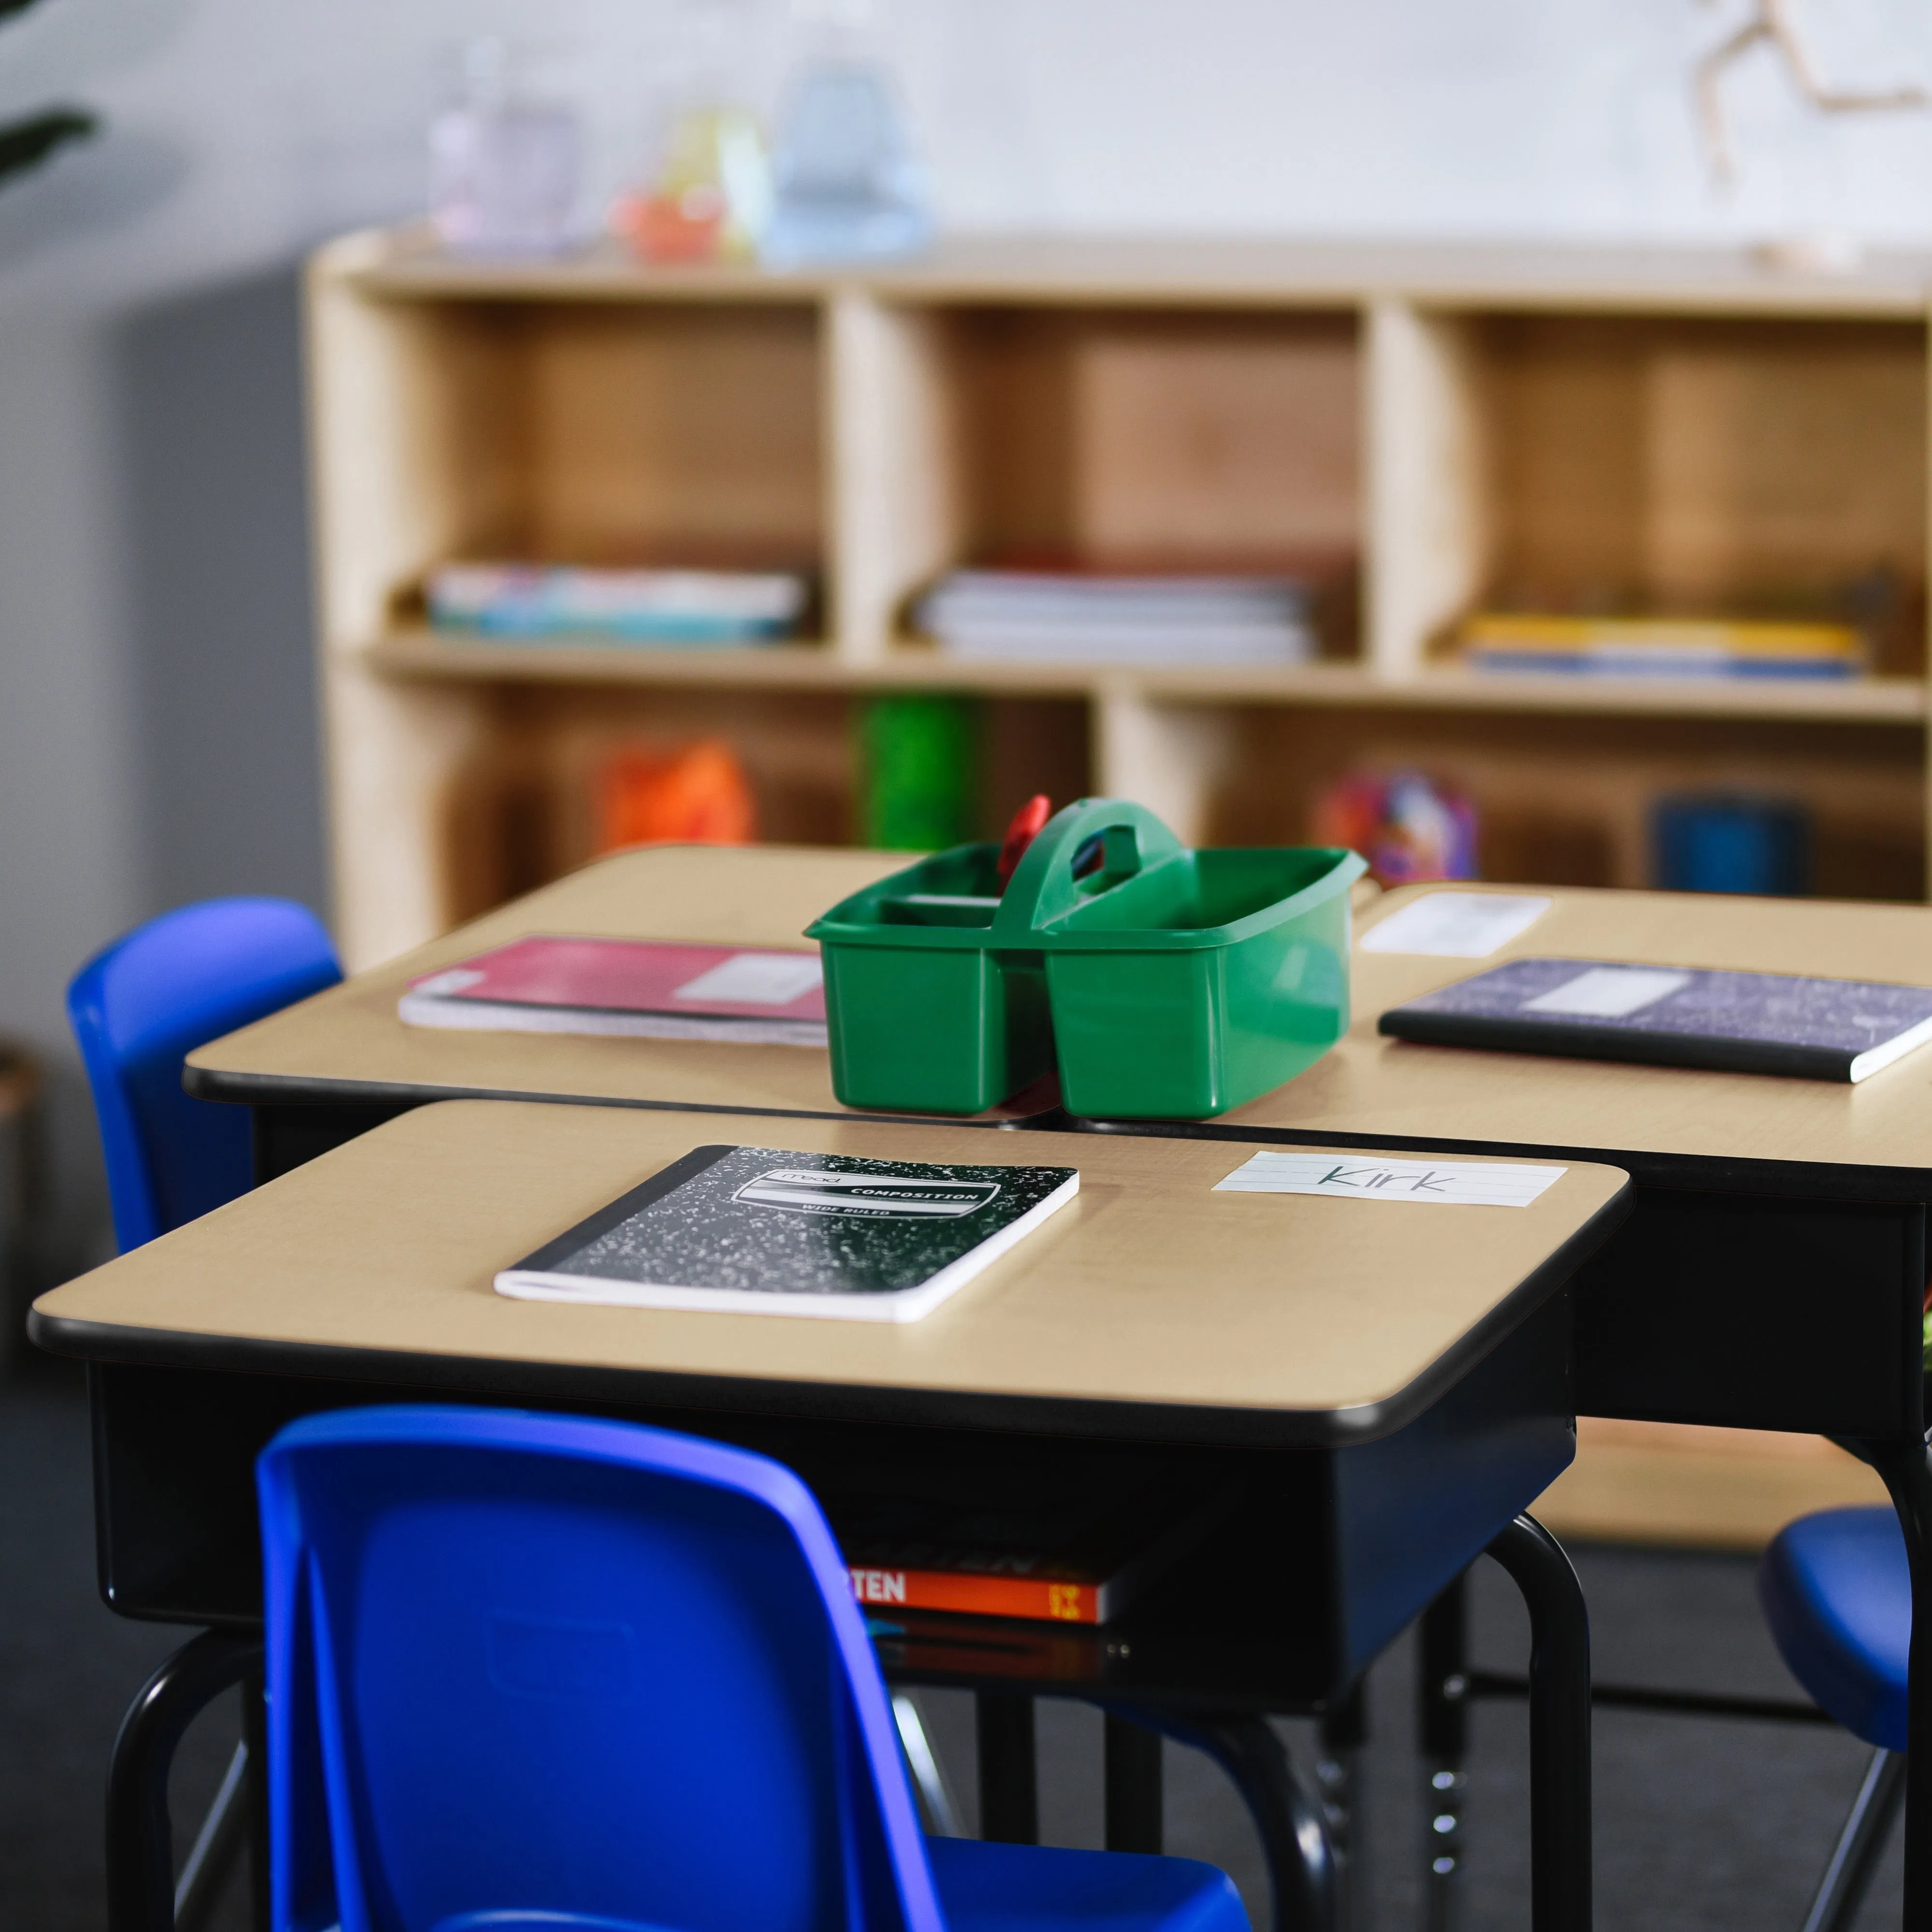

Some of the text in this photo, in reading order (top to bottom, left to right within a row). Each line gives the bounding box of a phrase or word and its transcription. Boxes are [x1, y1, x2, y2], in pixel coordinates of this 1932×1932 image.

[1317, 1165, 1457, 1192] Kirk
[851, 1188, 979, 1200] COMPOSITION
[843, 1208, 891, 1216] RULED
